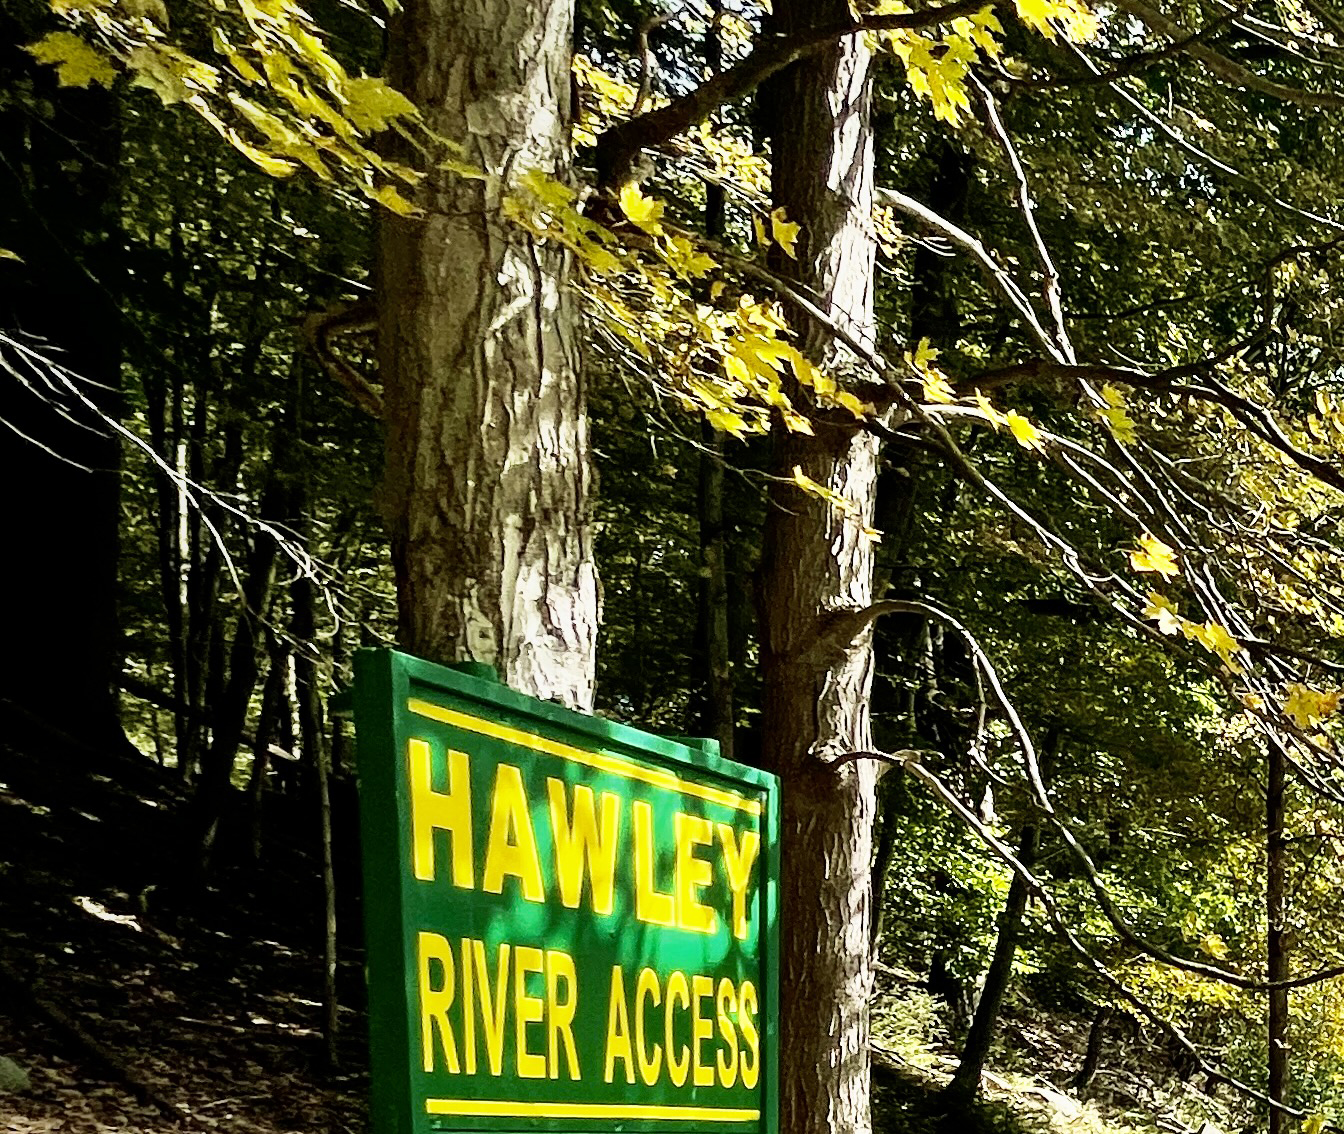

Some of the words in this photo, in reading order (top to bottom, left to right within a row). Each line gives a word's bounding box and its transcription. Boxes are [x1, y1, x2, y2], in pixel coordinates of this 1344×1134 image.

[408, 739, 760, 940] HAWLEY
[418, 931, 581, 1081] RIVER
[604, 965, 760, 1090] ACCESS
